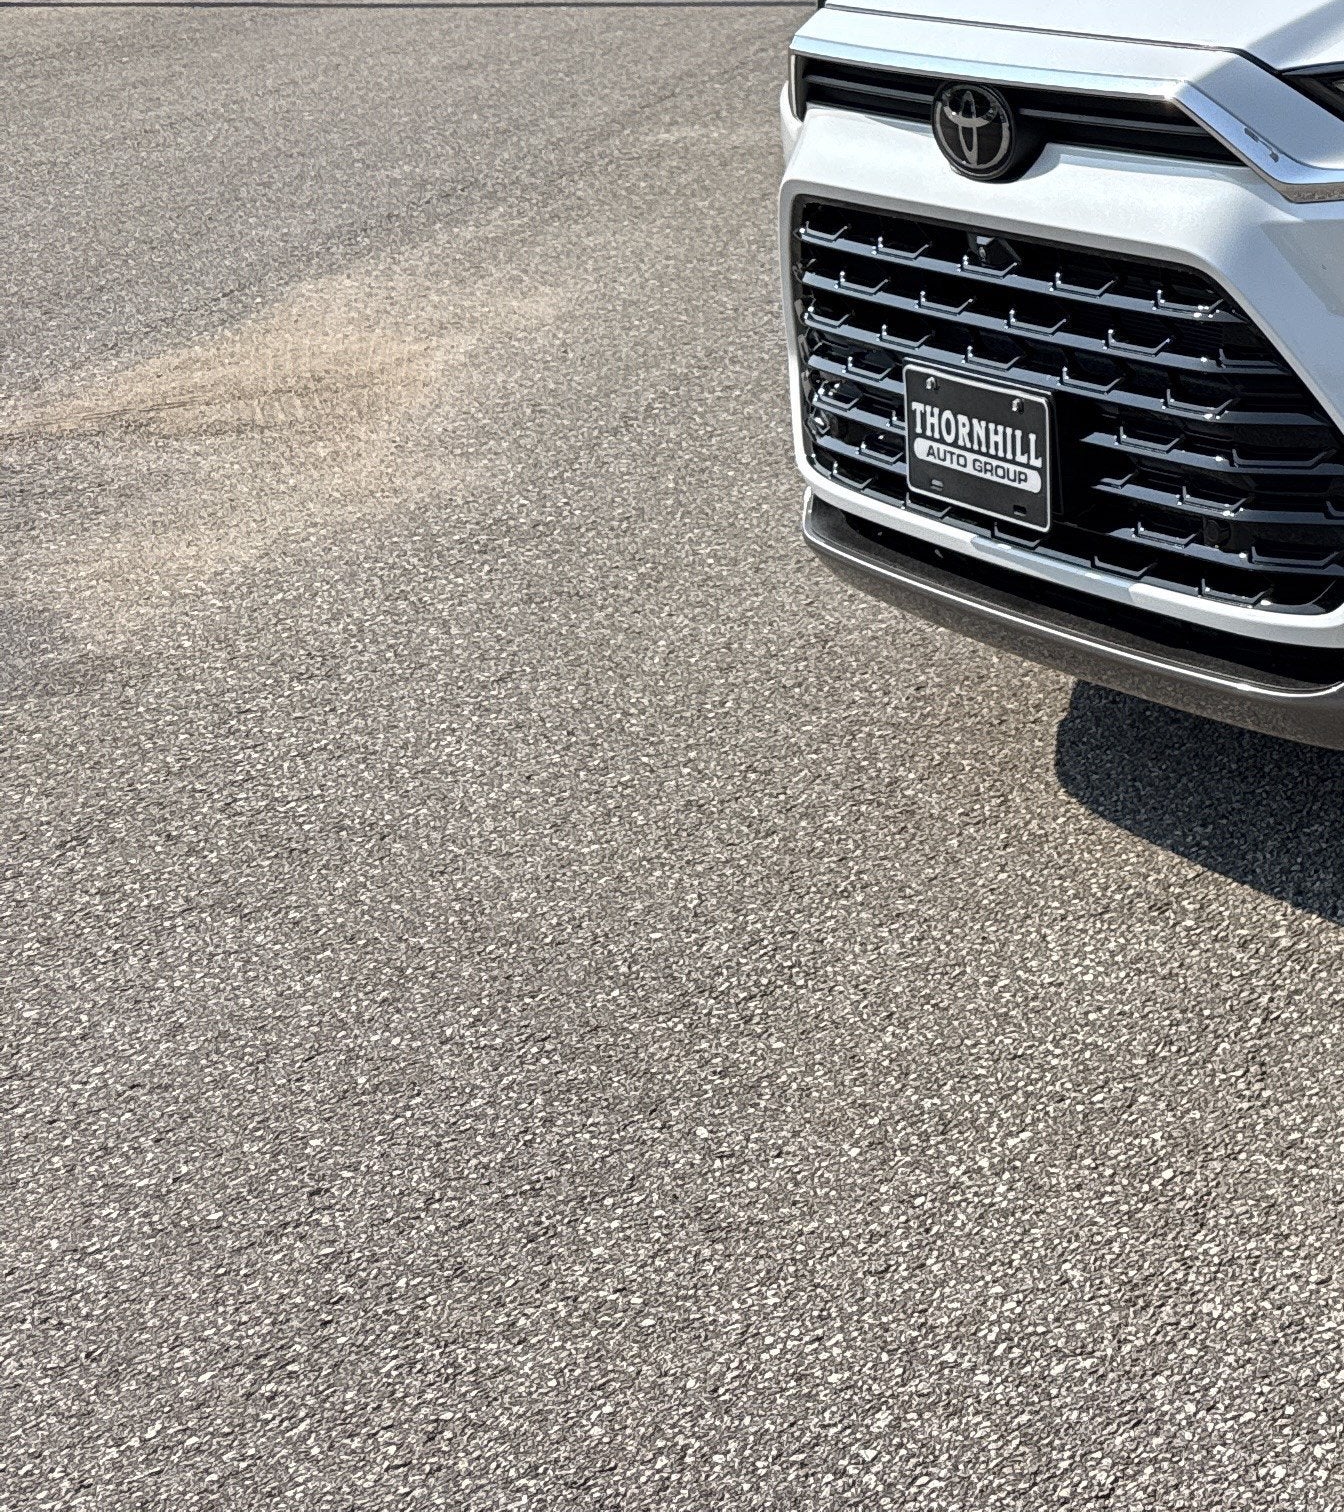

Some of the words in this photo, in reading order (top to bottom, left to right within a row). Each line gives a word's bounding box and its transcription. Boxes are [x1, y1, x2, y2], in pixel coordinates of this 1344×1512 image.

[911, 401, 1042, 468] THORNHILL
[926, 444, 968, 468] AUTO
[972, 458, 1028, 485] GROUP
